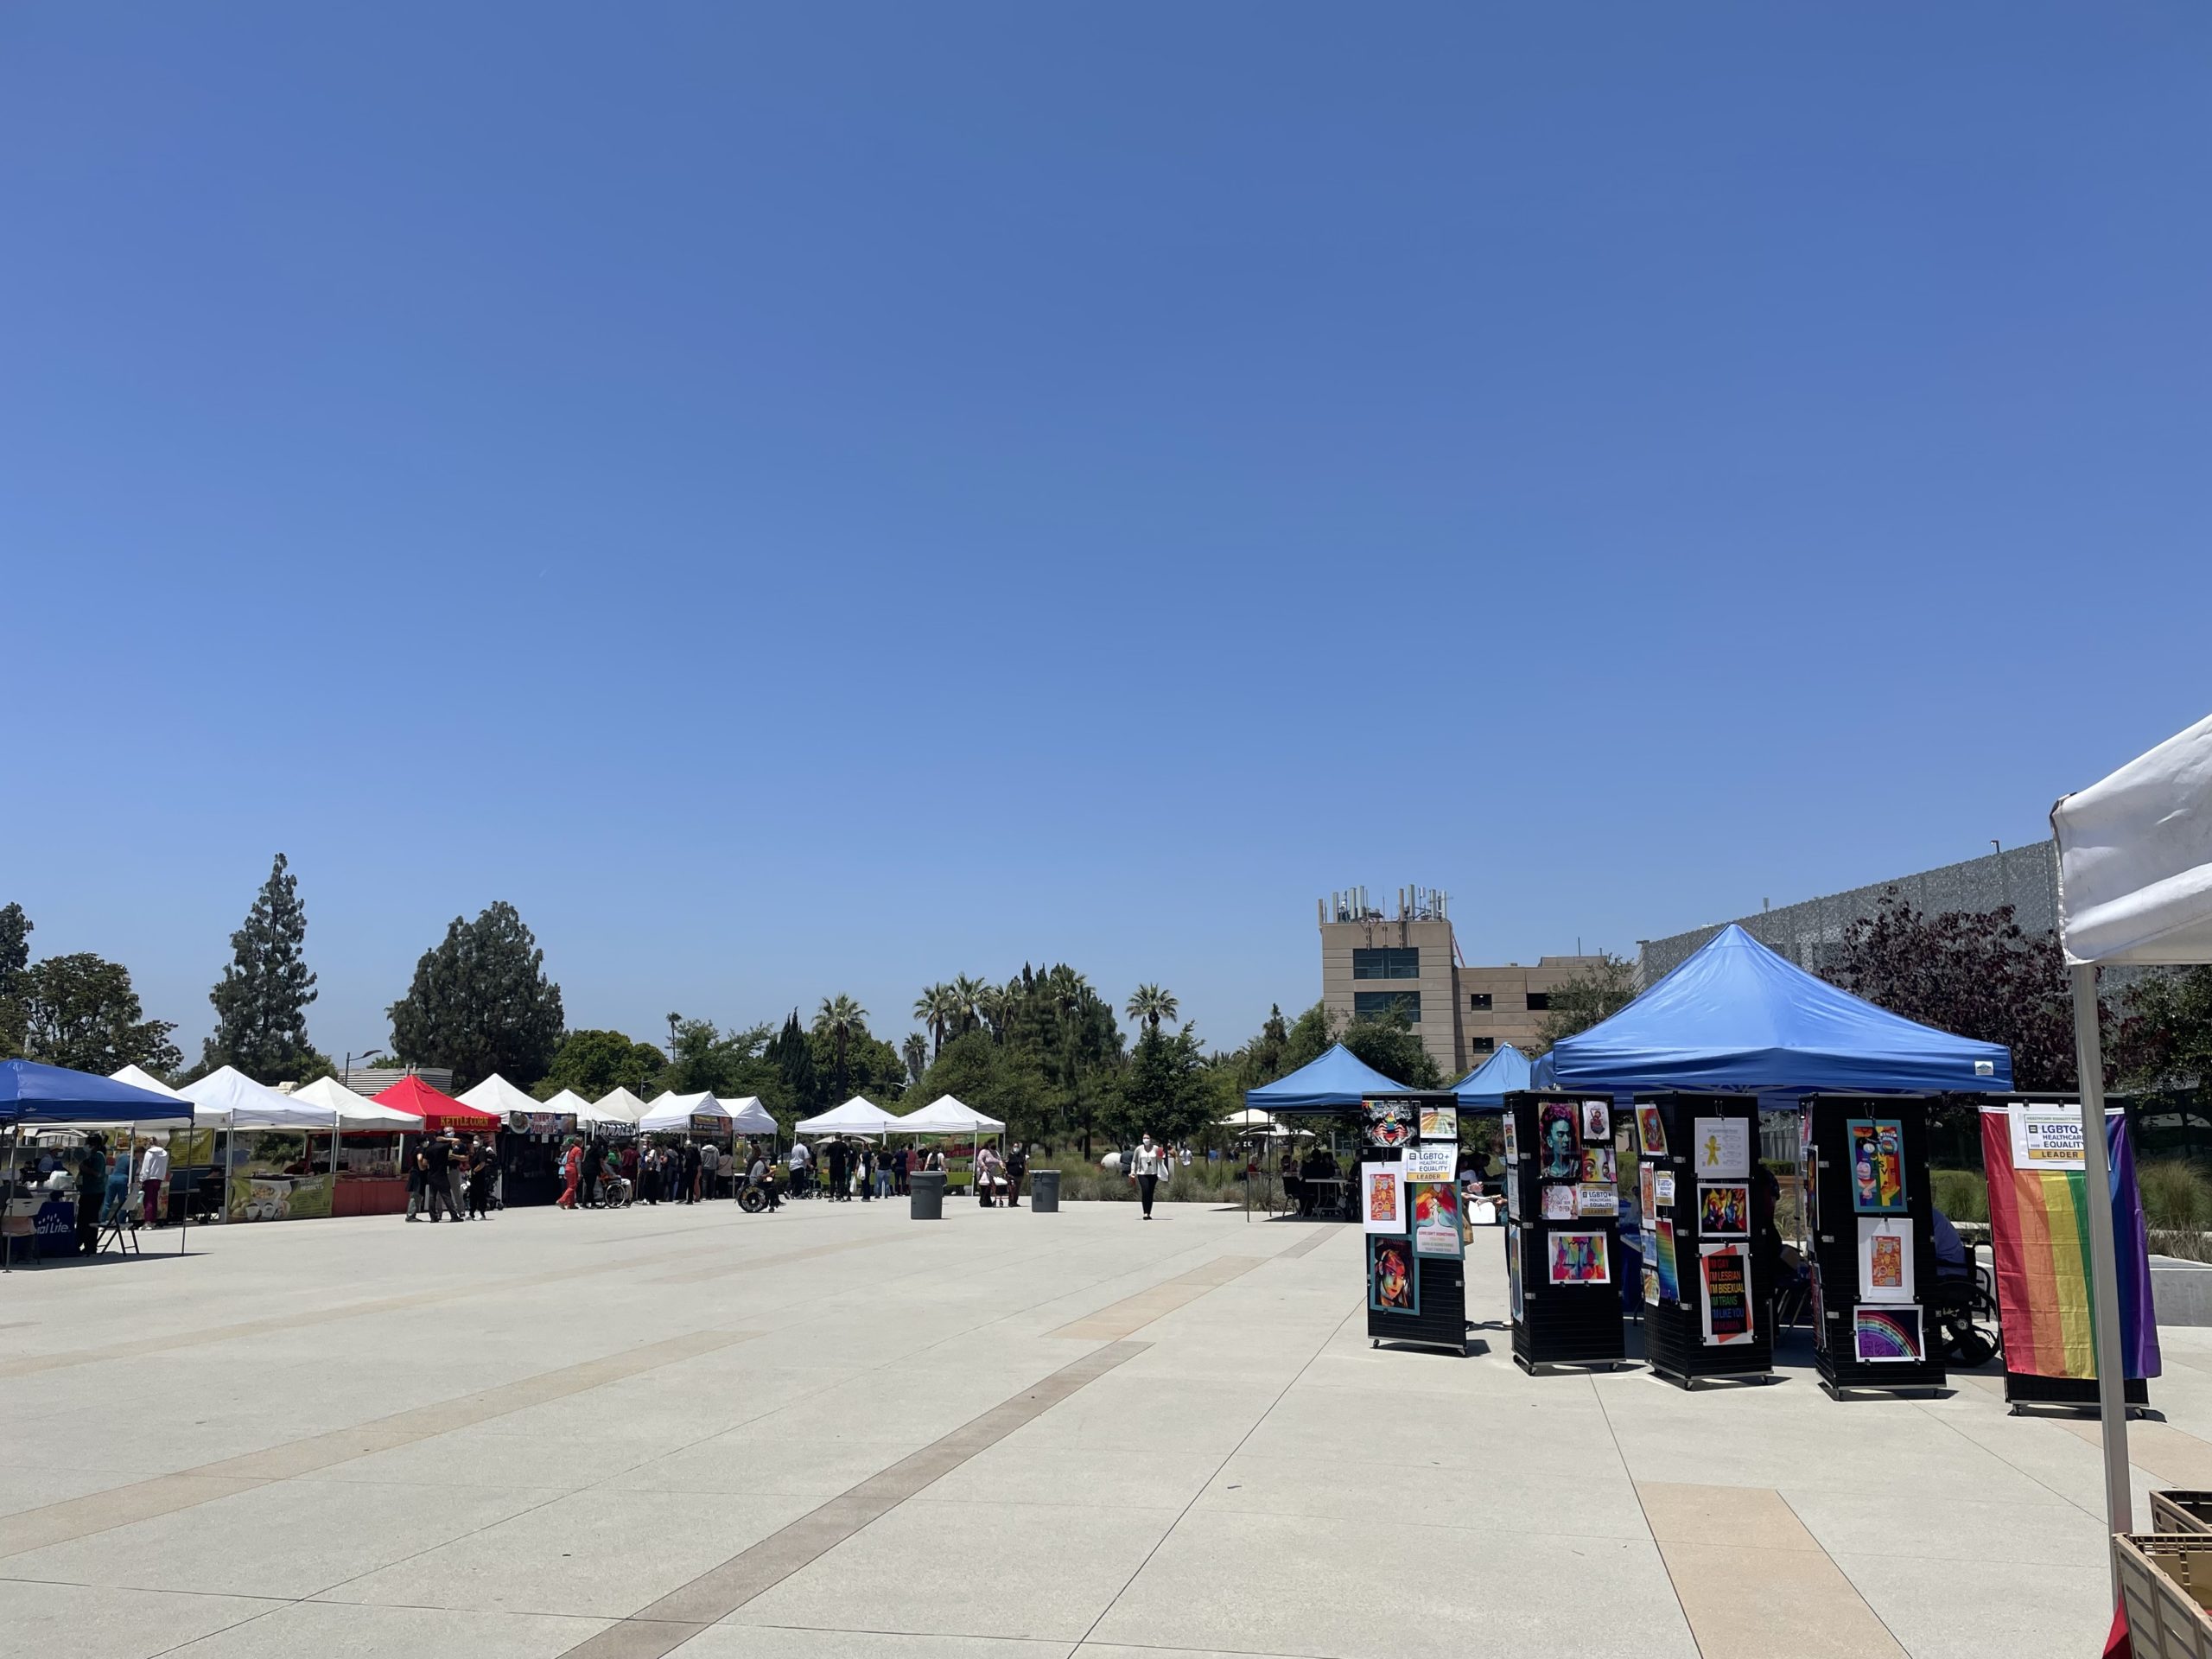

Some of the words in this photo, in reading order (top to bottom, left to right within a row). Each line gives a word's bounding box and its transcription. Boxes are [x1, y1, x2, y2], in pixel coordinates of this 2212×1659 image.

[441, 1116, 469, 1126] KETTLE
[470, 1116, 489, 1127] CORN
[49, 1222, 69, 1234] Life
[1718, 1270, 1741, 1281] LESBIAN
[1719, 1283, 1745, 1294] BISEXUAL
[1719, 1295, 1738, 1306] TRANS
[1719, 1308, 1732, 1319] LIKE
[1733, 1307, 1745, 1318] YOU
